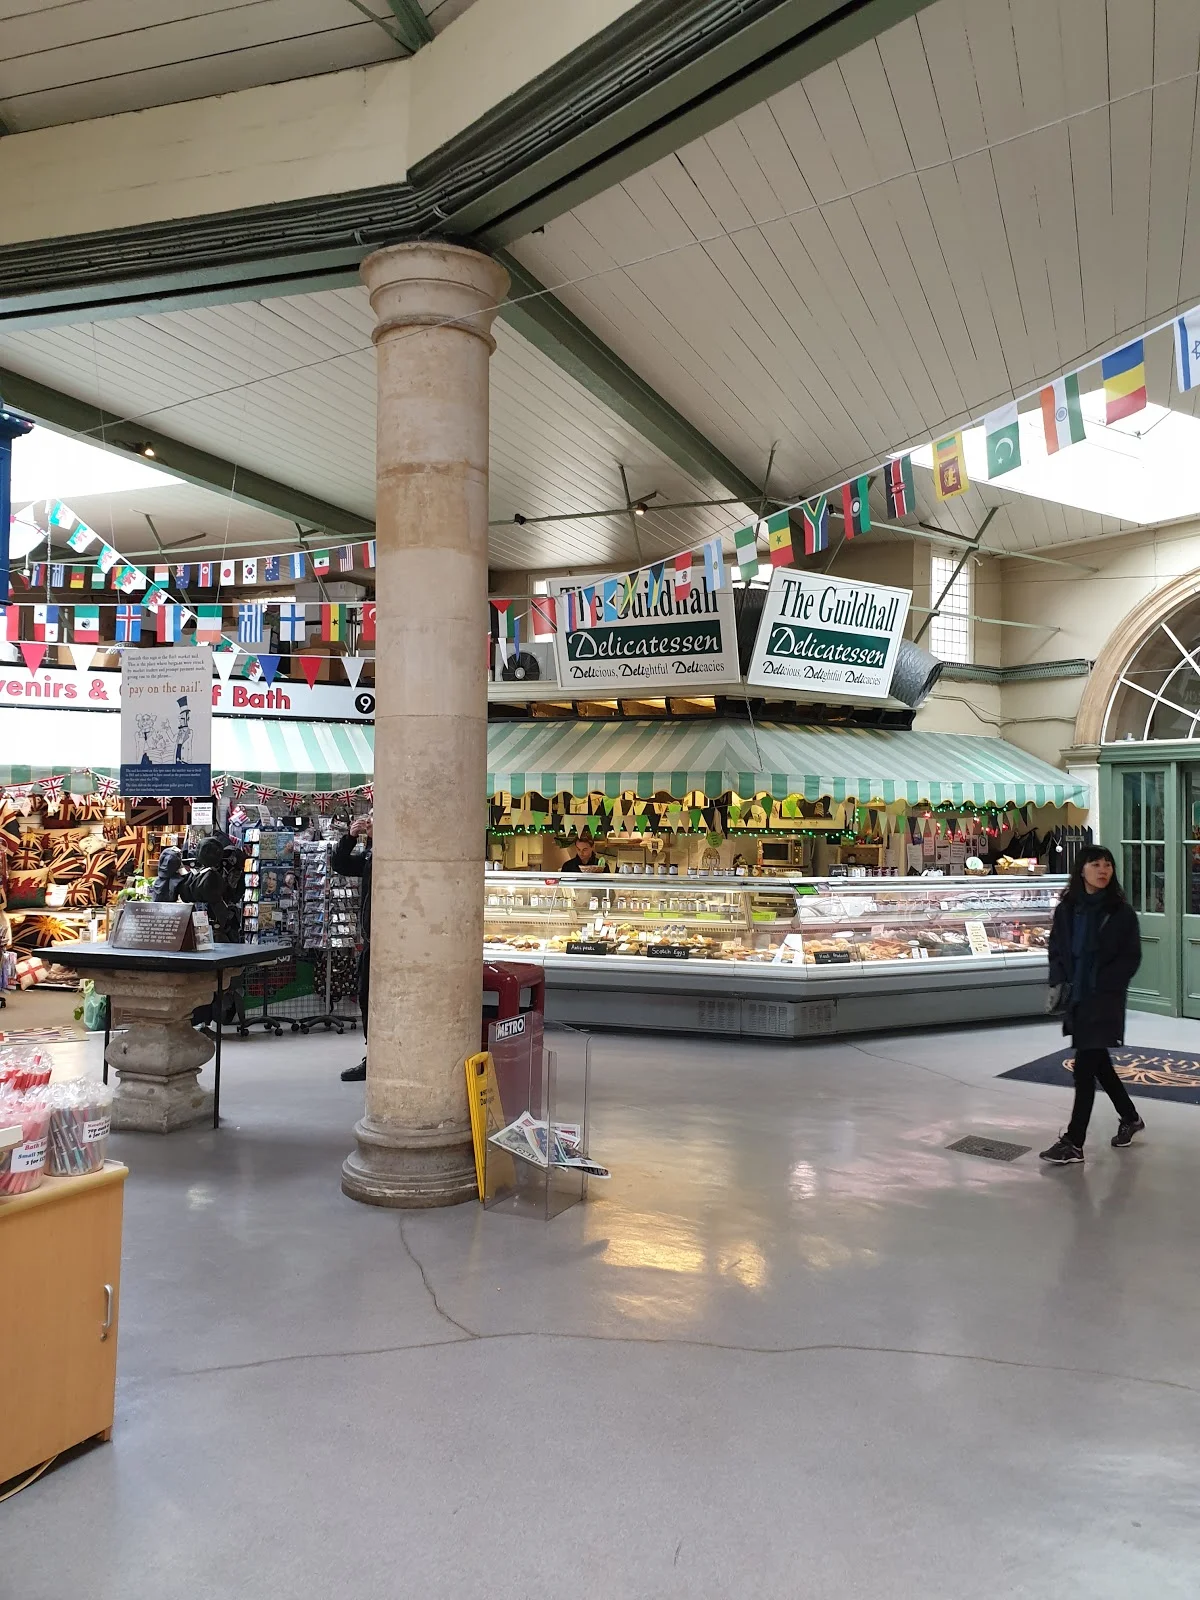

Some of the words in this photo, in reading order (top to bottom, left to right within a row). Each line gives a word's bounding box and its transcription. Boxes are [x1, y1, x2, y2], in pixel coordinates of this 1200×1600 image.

[778, 579, 814, 620] The
[818, 586, 900, 632] Guildhall
[568, 631, 719, 658] Delicatessen
[771, 626, 884, 666] Delicatessen
[569, 666, 619, 679] Delicious,
[618, 662, 669, 678] Delightful
[671, 660, 725, 675] Delicacies
[803, 665, 842, 682] Delightful
[844, 670, 881, 686] Delicacies
[89, 679, 108, 700] &
[212, 684, 222, 706] f
[233, 685, 291, 710] Bath
[162, 682, 177, 693] the
[360, 697, 371, 711] 9
[673, 948, 685, 957] Eggs
[498, 1019, 524, 1038] METRO
